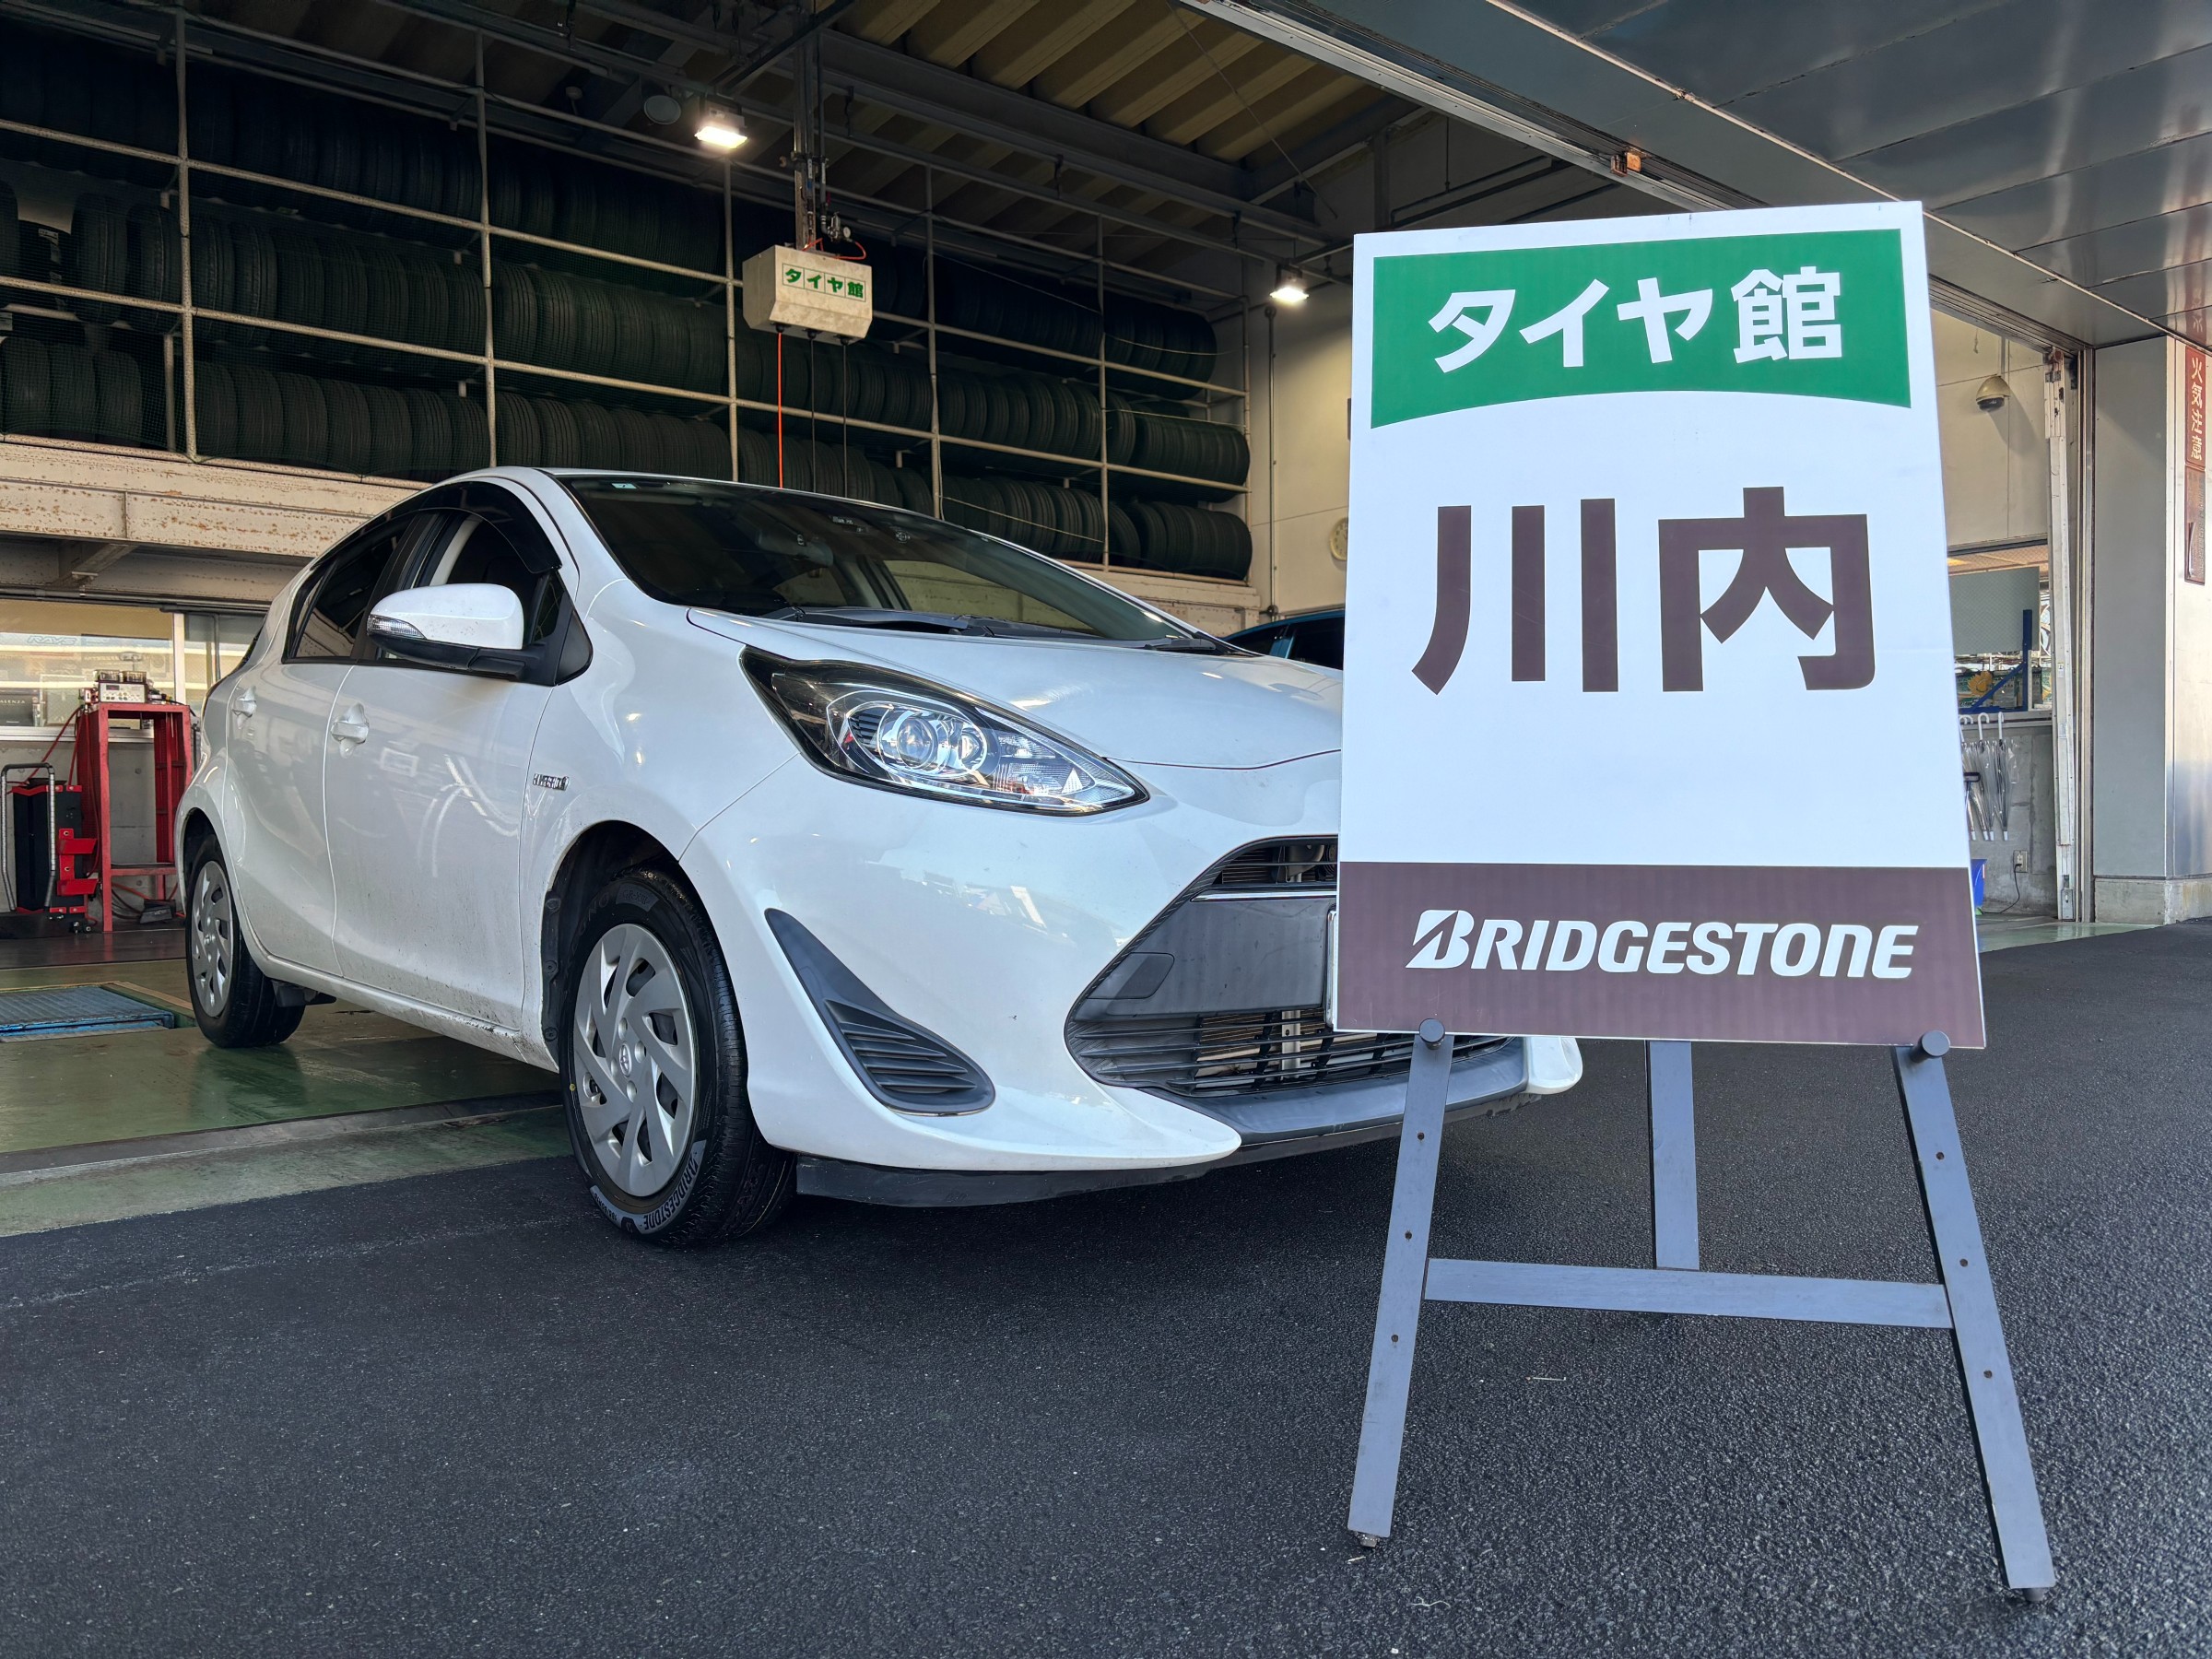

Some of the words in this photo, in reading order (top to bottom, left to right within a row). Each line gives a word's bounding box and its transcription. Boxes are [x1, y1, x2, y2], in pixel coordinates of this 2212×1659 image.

[785, 268, 864, 299] タイヤ館
[1428, 265, 1842, 374] タイヤ館
[2191, 357, 2203, 461] 火気注意
[1411, 486, 1876, 696] 川内
[27, 635, 76, 645] RAYS
[1406, 909, 1919, 979] BRIDGESTONE
[643, 1156, 699, 1230] BRIDGESTONE
